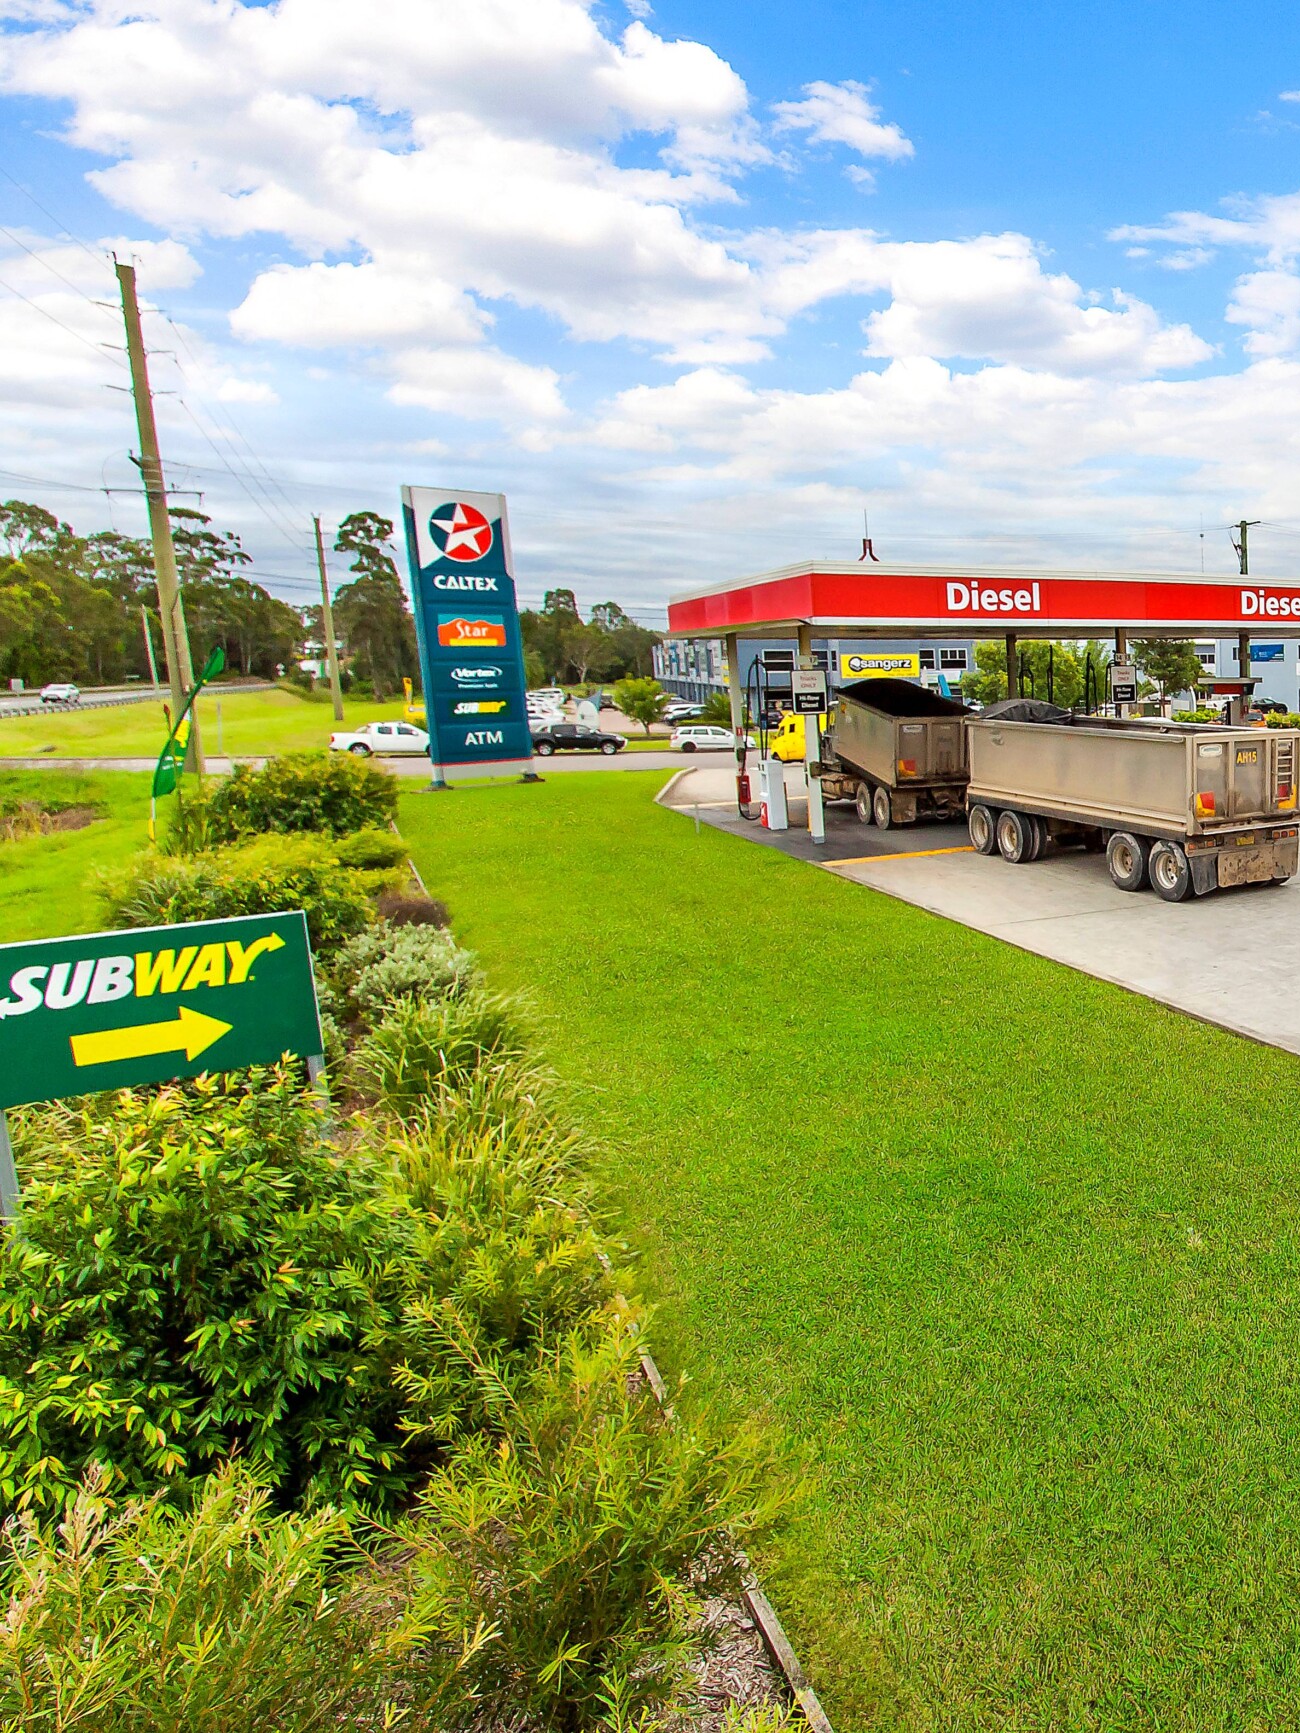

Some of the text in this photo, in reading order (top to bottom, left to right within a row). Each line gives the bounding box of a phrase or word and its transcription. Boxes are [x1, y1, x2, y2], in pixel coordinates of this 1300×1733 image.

[433, 574, 499, 592] CALTEX
[946, 580, 1041, 612] Diesel
[455, 620, 489, 640] Star
[455, 667, 497, 678] Vortex
[860, 659, 912, 672] sangerz
[465, 731, 504, 746] ATM
[1236, 751, 1257, 764] AH15
[0, 932, 286, 1020] SUBWAY
